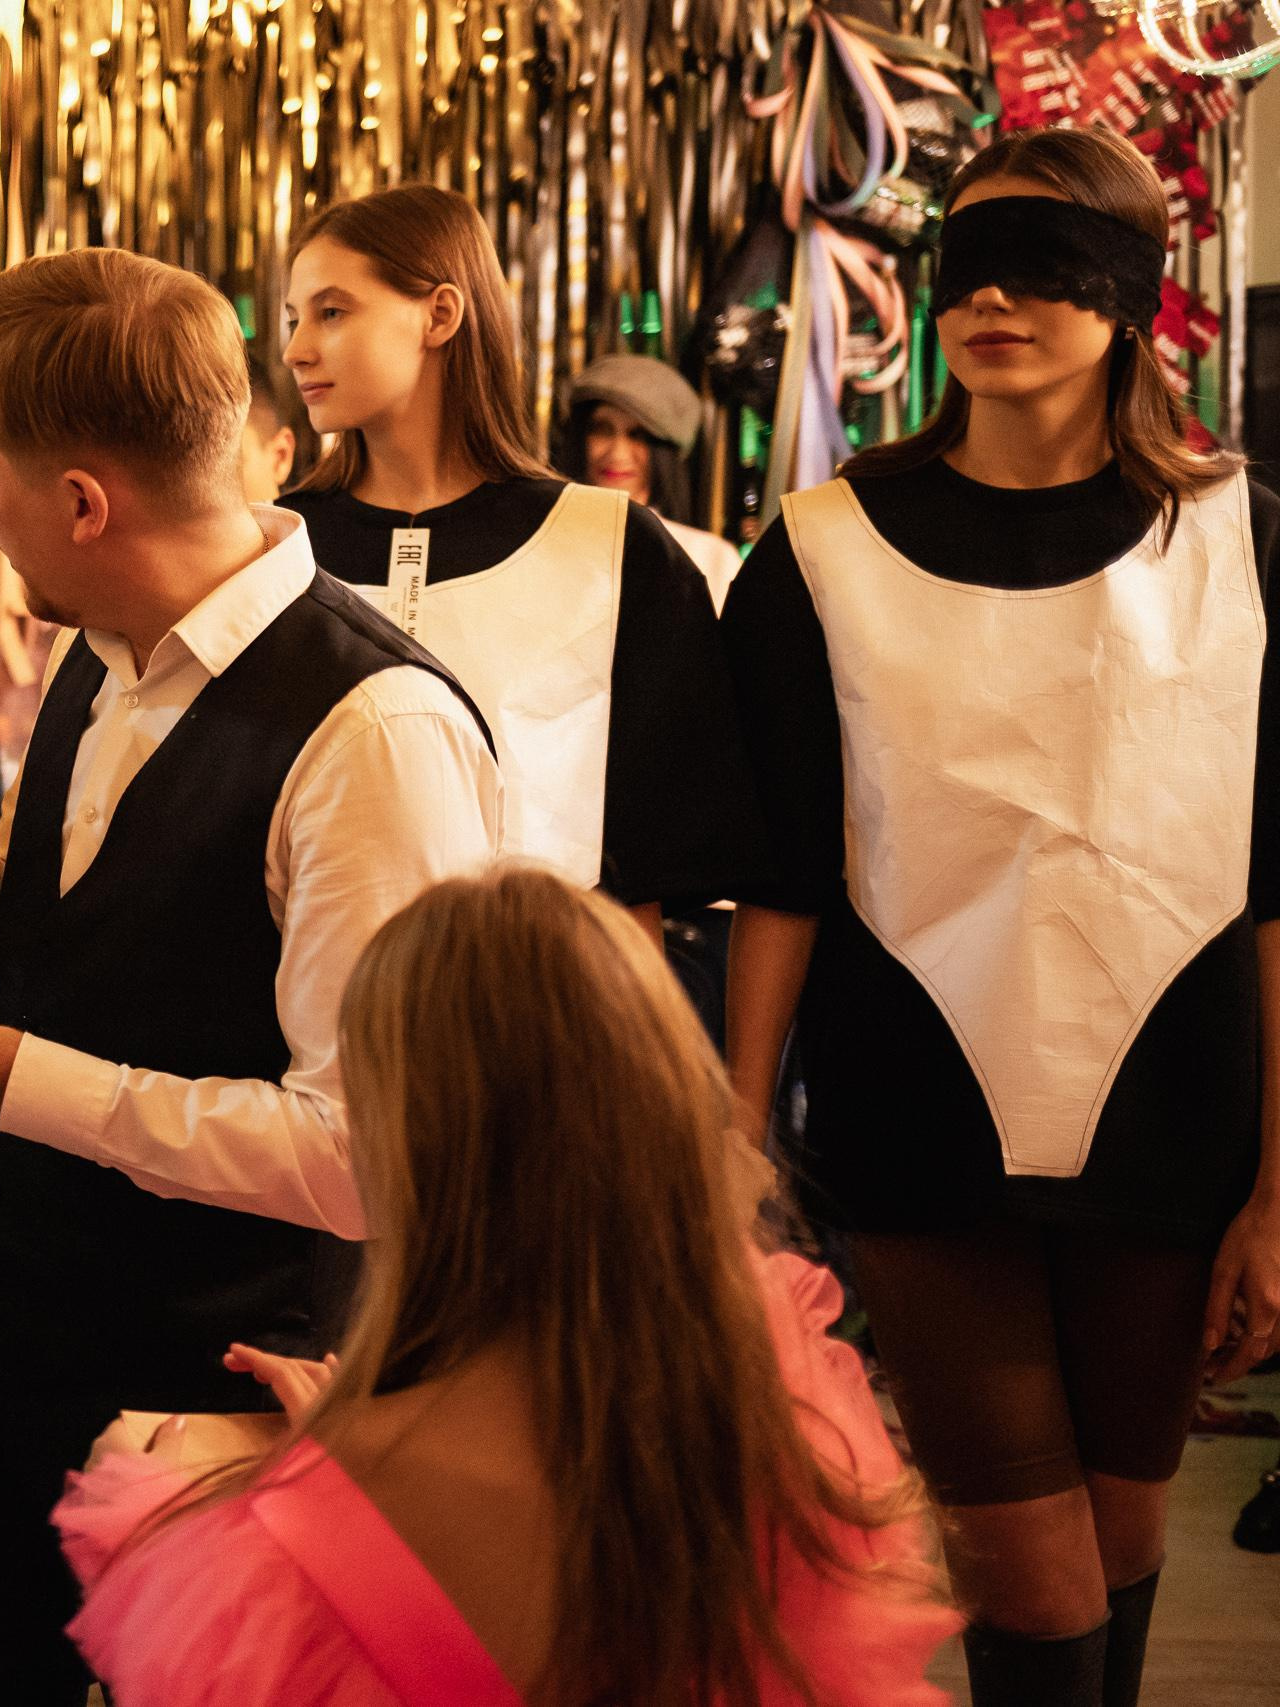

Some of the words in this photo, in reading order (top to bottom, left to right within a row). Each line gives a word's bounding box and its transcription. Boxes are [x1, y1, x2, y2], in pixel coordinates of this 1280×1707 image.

[397, 545, 422, 566] EAC
[409, 576, 420, 604] MADE
[408, 610, 417, 621] IN
[407, 627, 416, 637] M
